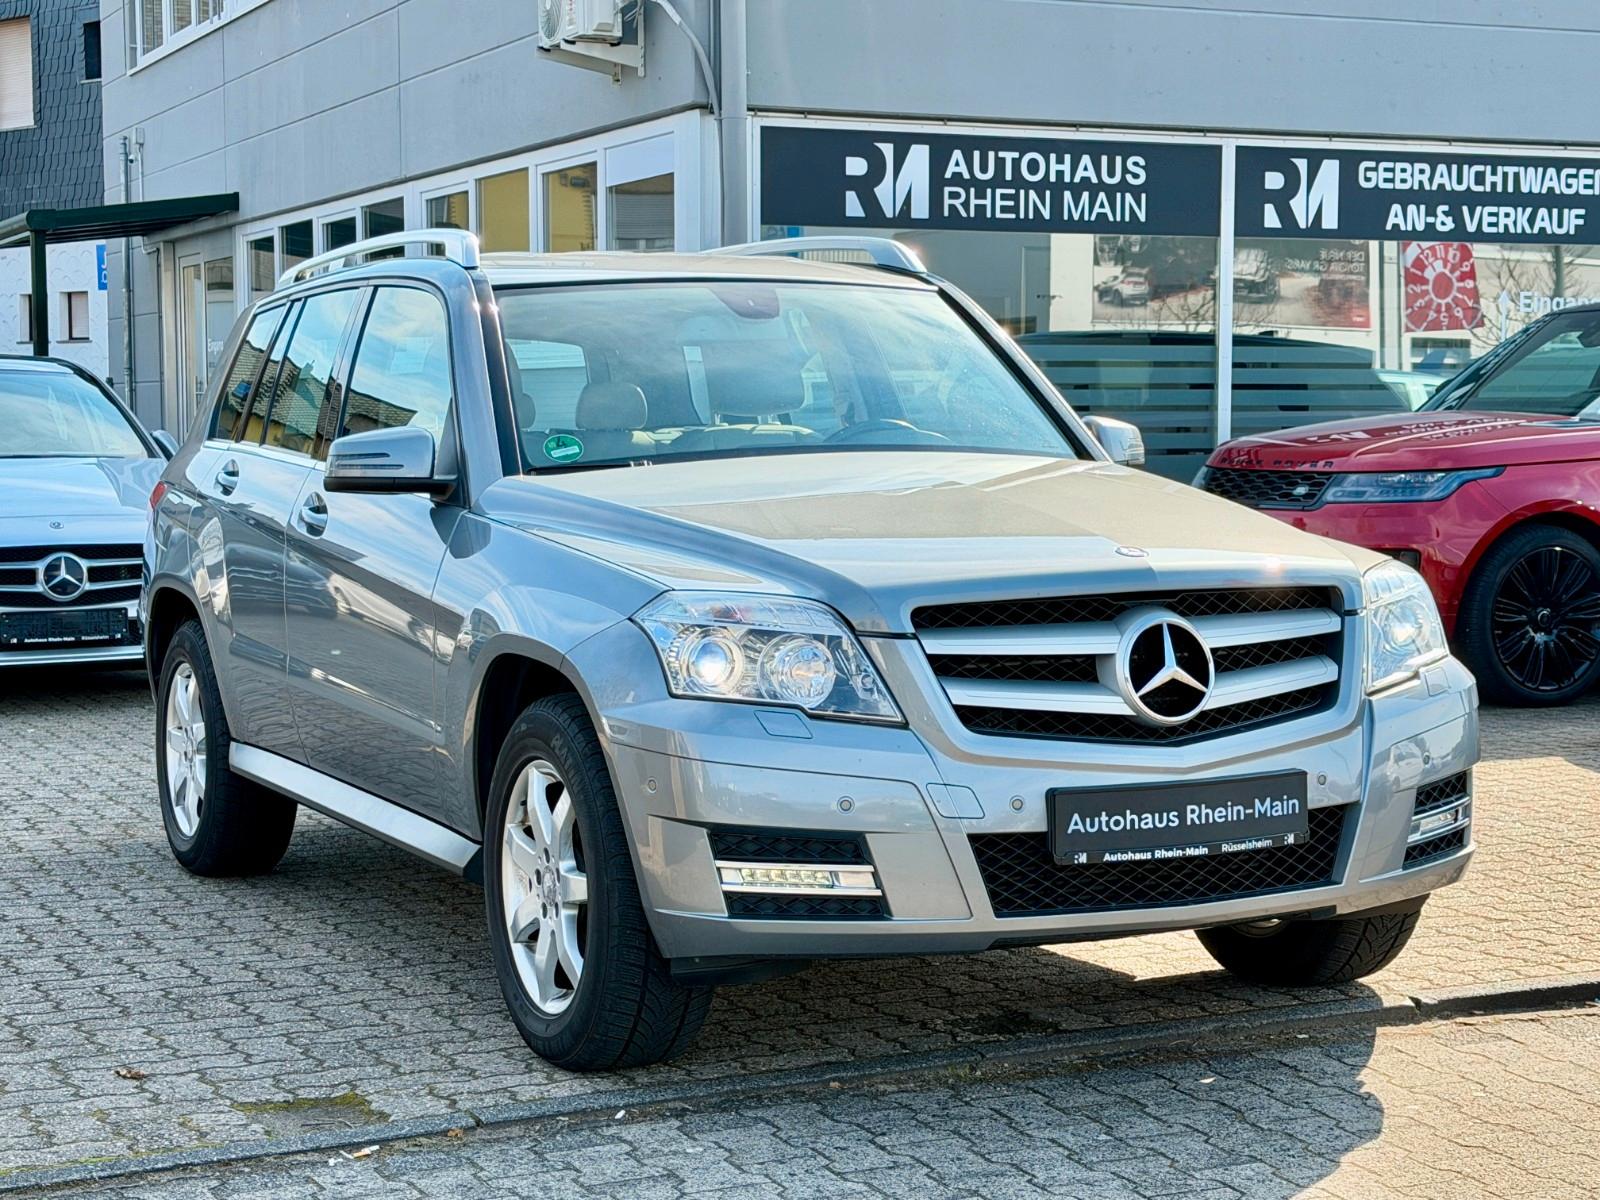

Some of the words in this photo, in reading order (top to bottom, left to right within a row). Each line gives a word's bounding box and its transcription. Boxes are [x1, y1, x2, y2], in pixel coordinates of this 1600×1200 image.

[944, 149, 1147, 185] AUTOHAUS
[943, 186, 1052, 220] RHEIN
[1063, 191, 1147, 223] MAIN
[1385, 203, 1455, 232] AN-&
[1462, 205, 1586, 235] VERKAUF
[1067, 810, 1179, 834] Autohaus
[1186, 795, 1299, 825] Rhein-Main
[1103, 850, 1152, 862] Autohaus
[1154, 845, 1208, 859] Rhein-Main
[1221, 838, 1273, 853] Rüsselsheim
